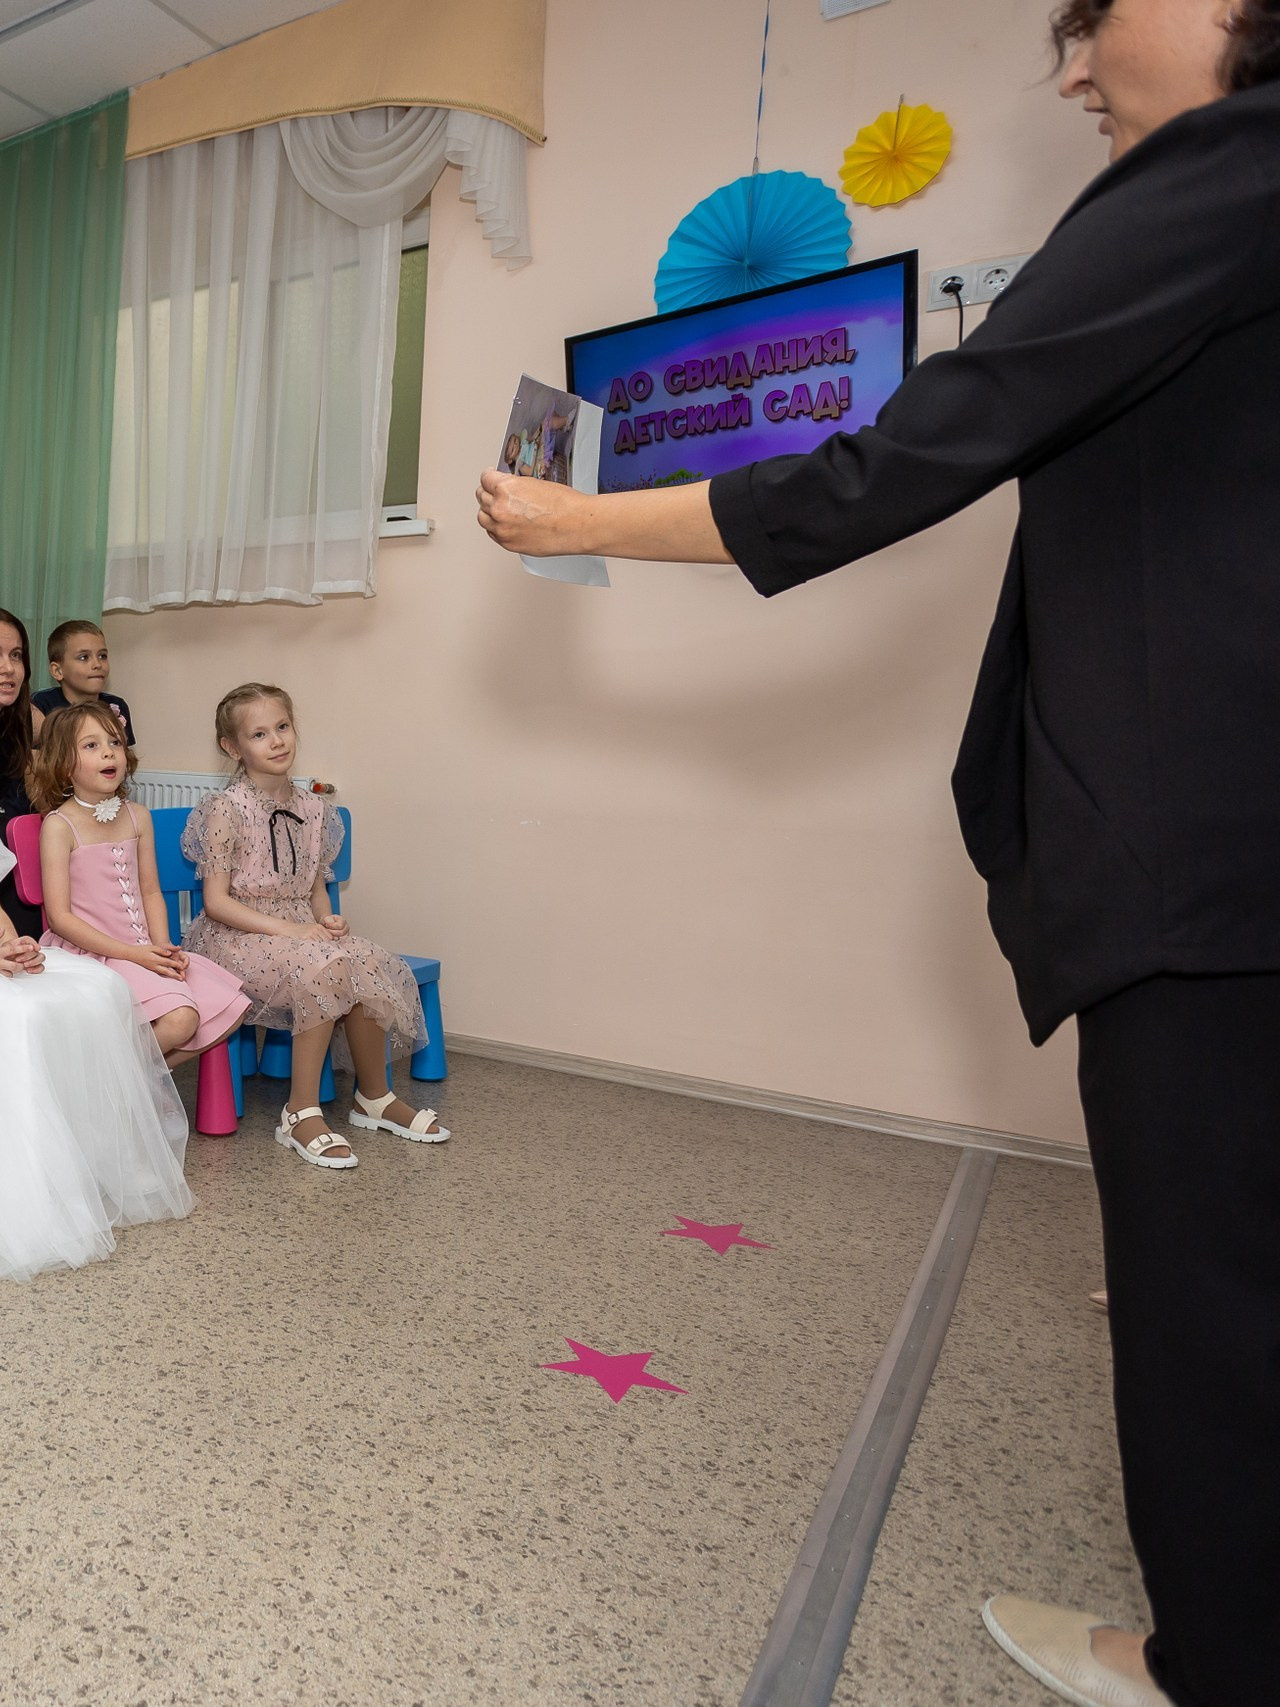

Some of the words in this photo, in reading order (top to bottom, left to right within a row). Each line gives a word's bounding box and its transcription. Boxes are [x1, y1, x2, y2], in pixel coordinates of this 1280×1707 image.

[607, 371, 653, 412] ДО
[663, 327, 857, 394] СВИДАНИЯ,
[614, 393, 751, 453] ДЕТСКИЙ
[762, 376, 851, 421] САД!
